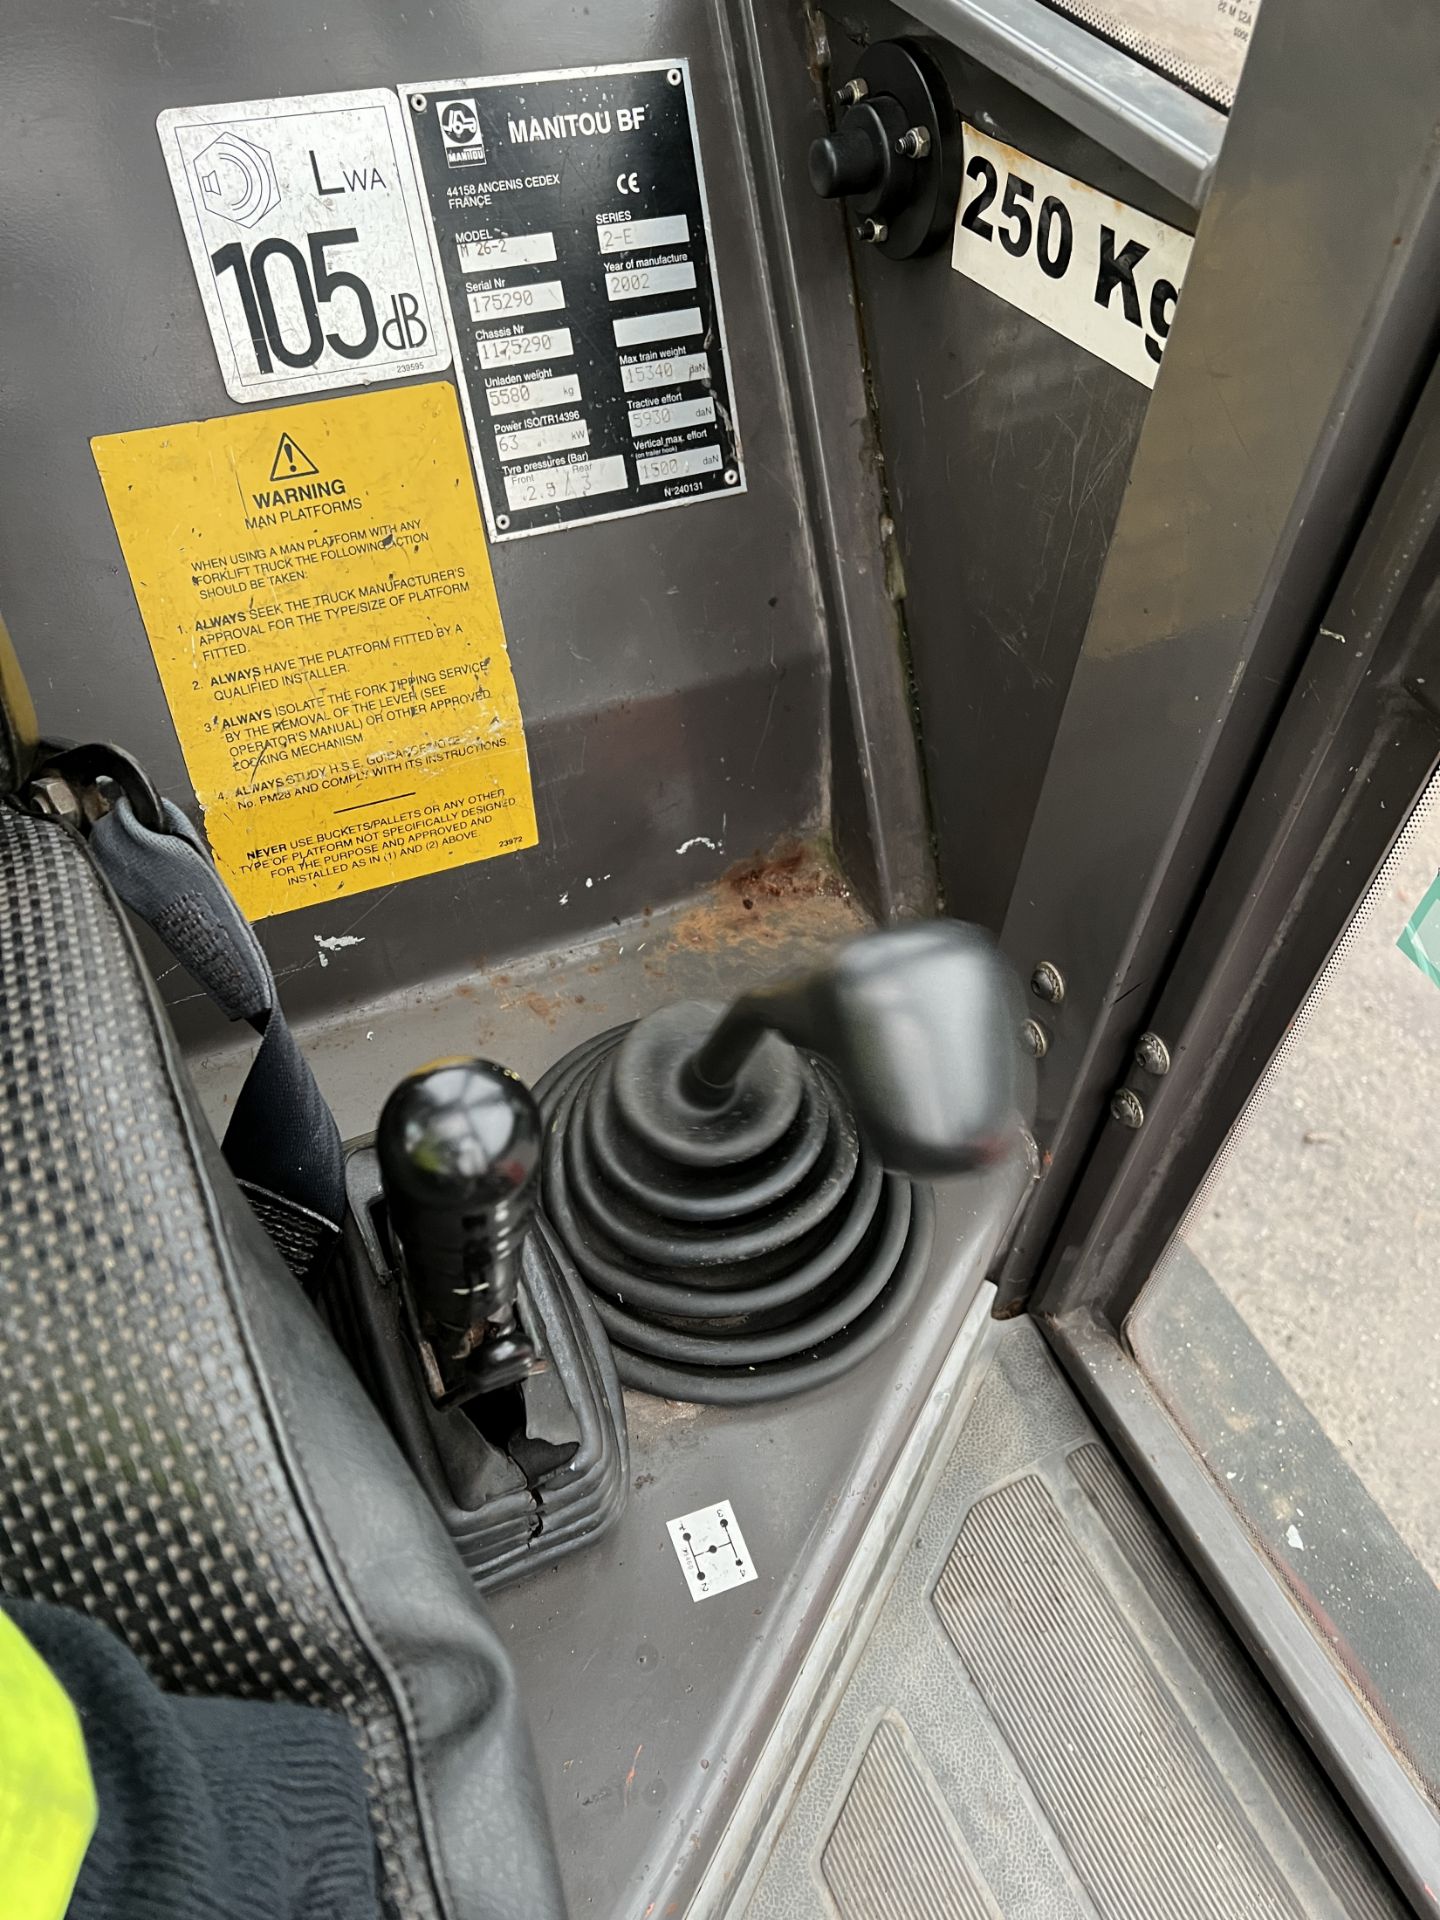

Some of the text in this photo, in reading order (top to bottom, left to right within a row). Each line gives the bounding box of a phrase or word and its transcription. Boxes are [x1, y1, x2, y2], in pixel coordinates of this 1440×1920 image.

[507, 106, 646, 143] MANITOU BF
[447, 148, 485, 164] MANITOU
[446, 174, 560, 197] 44158 ANCENIS CEDEX
[448, 195, 492, 210] FRANCE
[596, 211, 631, 224] SERIES
[455, 230, 493, 243] MODEL
[477, 239, 508, 256] 26-2
[602, 228, 633, 249] 2-E
[604, 253, 688, 272] Year of manufacture
[961, 155, 1180, 364] 250 Kg
[466, 278, 505, 292] Serial Nr
[610, 274, 650, 293] 2002
[211, 227, 427, 375] 105 dB
[473, 290, 533, 313] 175290
[475, 324, 524, 340] Chassis Nr
[482, 334, 551, 359] 1175290
[619, 346, 686, 364] Max train weight
[485, 368, 552, 387] Unladen weight
[627, 363, 672, 383] 15340
[490, 385, 574, 406] 5580 kg
[627, 393, 682, 409] Tractive effort
[494, 411, 580, 433] Power ISO/TR14396
[633, 407, 712, 428] 5930 daN
[500, 430, 584, 452] 63 kW
[634, 438, 663, 450] Vertical
[687, 429, 707, 440] effort
[502, 452, 588, 475] Tyre pressures (Bar)
[646, 449, 661, 457] trailer
[512, 464, 592, 485] Front Rear
[642, 455, 719, 479] 1500 daN
[252, 479, 346, 509] WARNING
[245, 498, 362, 530] MAN PLATFORMS
[191, 519, 421, 572] WHEN USING MAN PLATFORM WITH ANY
[255, 559, 293, 574] TRUCK
[296, 554, 318, 566] THE
[321, 540, 385, 560] FOLLOWING
[200, 571, 308, 600] SHOULD BE TAKEN:
[195, 567, 465, 631] ALWAYS SEEK THE TRUCK MANUFACTURER'S
[200, 582, 469, 646] APPROVAL FOR THE TYPE/SIZE OF PLATFORM
[203, 643, 250, 661] FITTED.
[211, 630, 434, 687] ALWAYS HAVE THE PLATFORM FITTED
[214, 664, 350, 701] QUALIFIED INSTALLER.
[222, 661, 488, 729] ALWAYS ISOLATE THE FORK TIPPING SERVICE
[230, 689, 491, 757] OPERATOR'S MANUAL) OTHER APPROVED
[245, 685, 447, 738] THE REMOVAL THE LEVER (SEE
[233, 733, 364, 771] LOCKING MECHANISM
[235, 778, 284, 797] ALWAYS
[286, 767, 326, 785] STUDY
[295, 783, 319, 796] AND
[322, 771, 369, 790] COMPLY
[372, 761, 402, 777] WITH
[405, 758, 423, 769] ITS
[240, 798, 516, 874] TYPE PLATFORM NOT SPECIFICALLY DESIGNED
[247, 788, 505, 861] NEVER USE BUCKETS/PALLETS OR ANY OTHER
[271, 815, 492, 879] FOR THE PURPOSE AND APPROVED AND
[499, 836, 523, 847] 23972
[288, 864, 348, 886] INSTALLED
[351, 858, 367, 870] AS
[400, 842, 423, 857] AND
[426, 841, 439, 852] (2)
